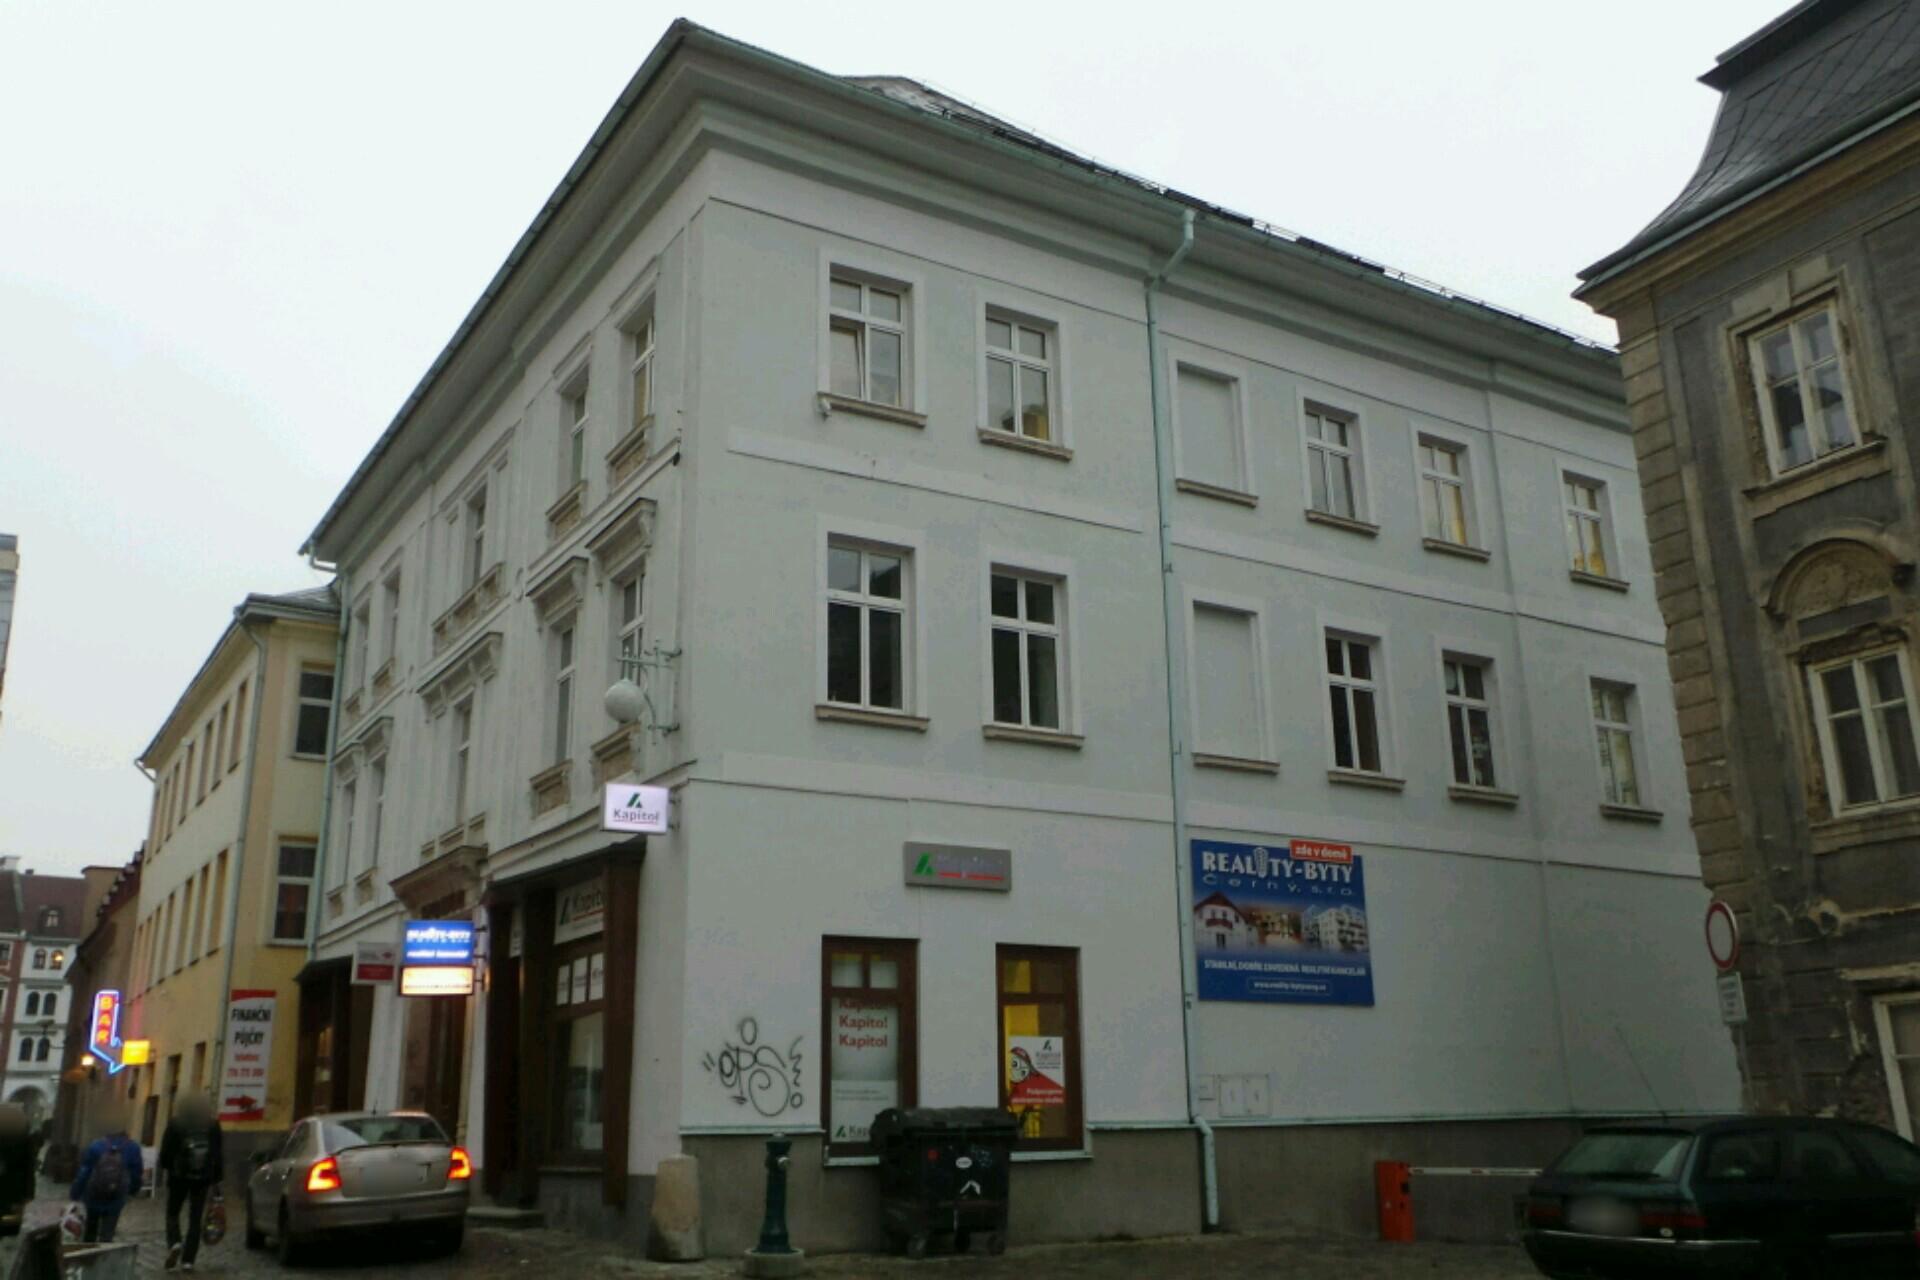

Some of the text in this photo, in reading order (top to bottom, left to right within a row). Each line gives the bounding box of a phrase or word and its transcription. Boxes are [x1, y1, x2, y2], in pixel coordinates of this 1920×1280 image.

[613, 807, 660, 822] Kapitol
[1295, 844, 1312, 857] zde
[96, 996, 113, 1043] BAR
[839, 1034, 888, 1050] Kapitol
